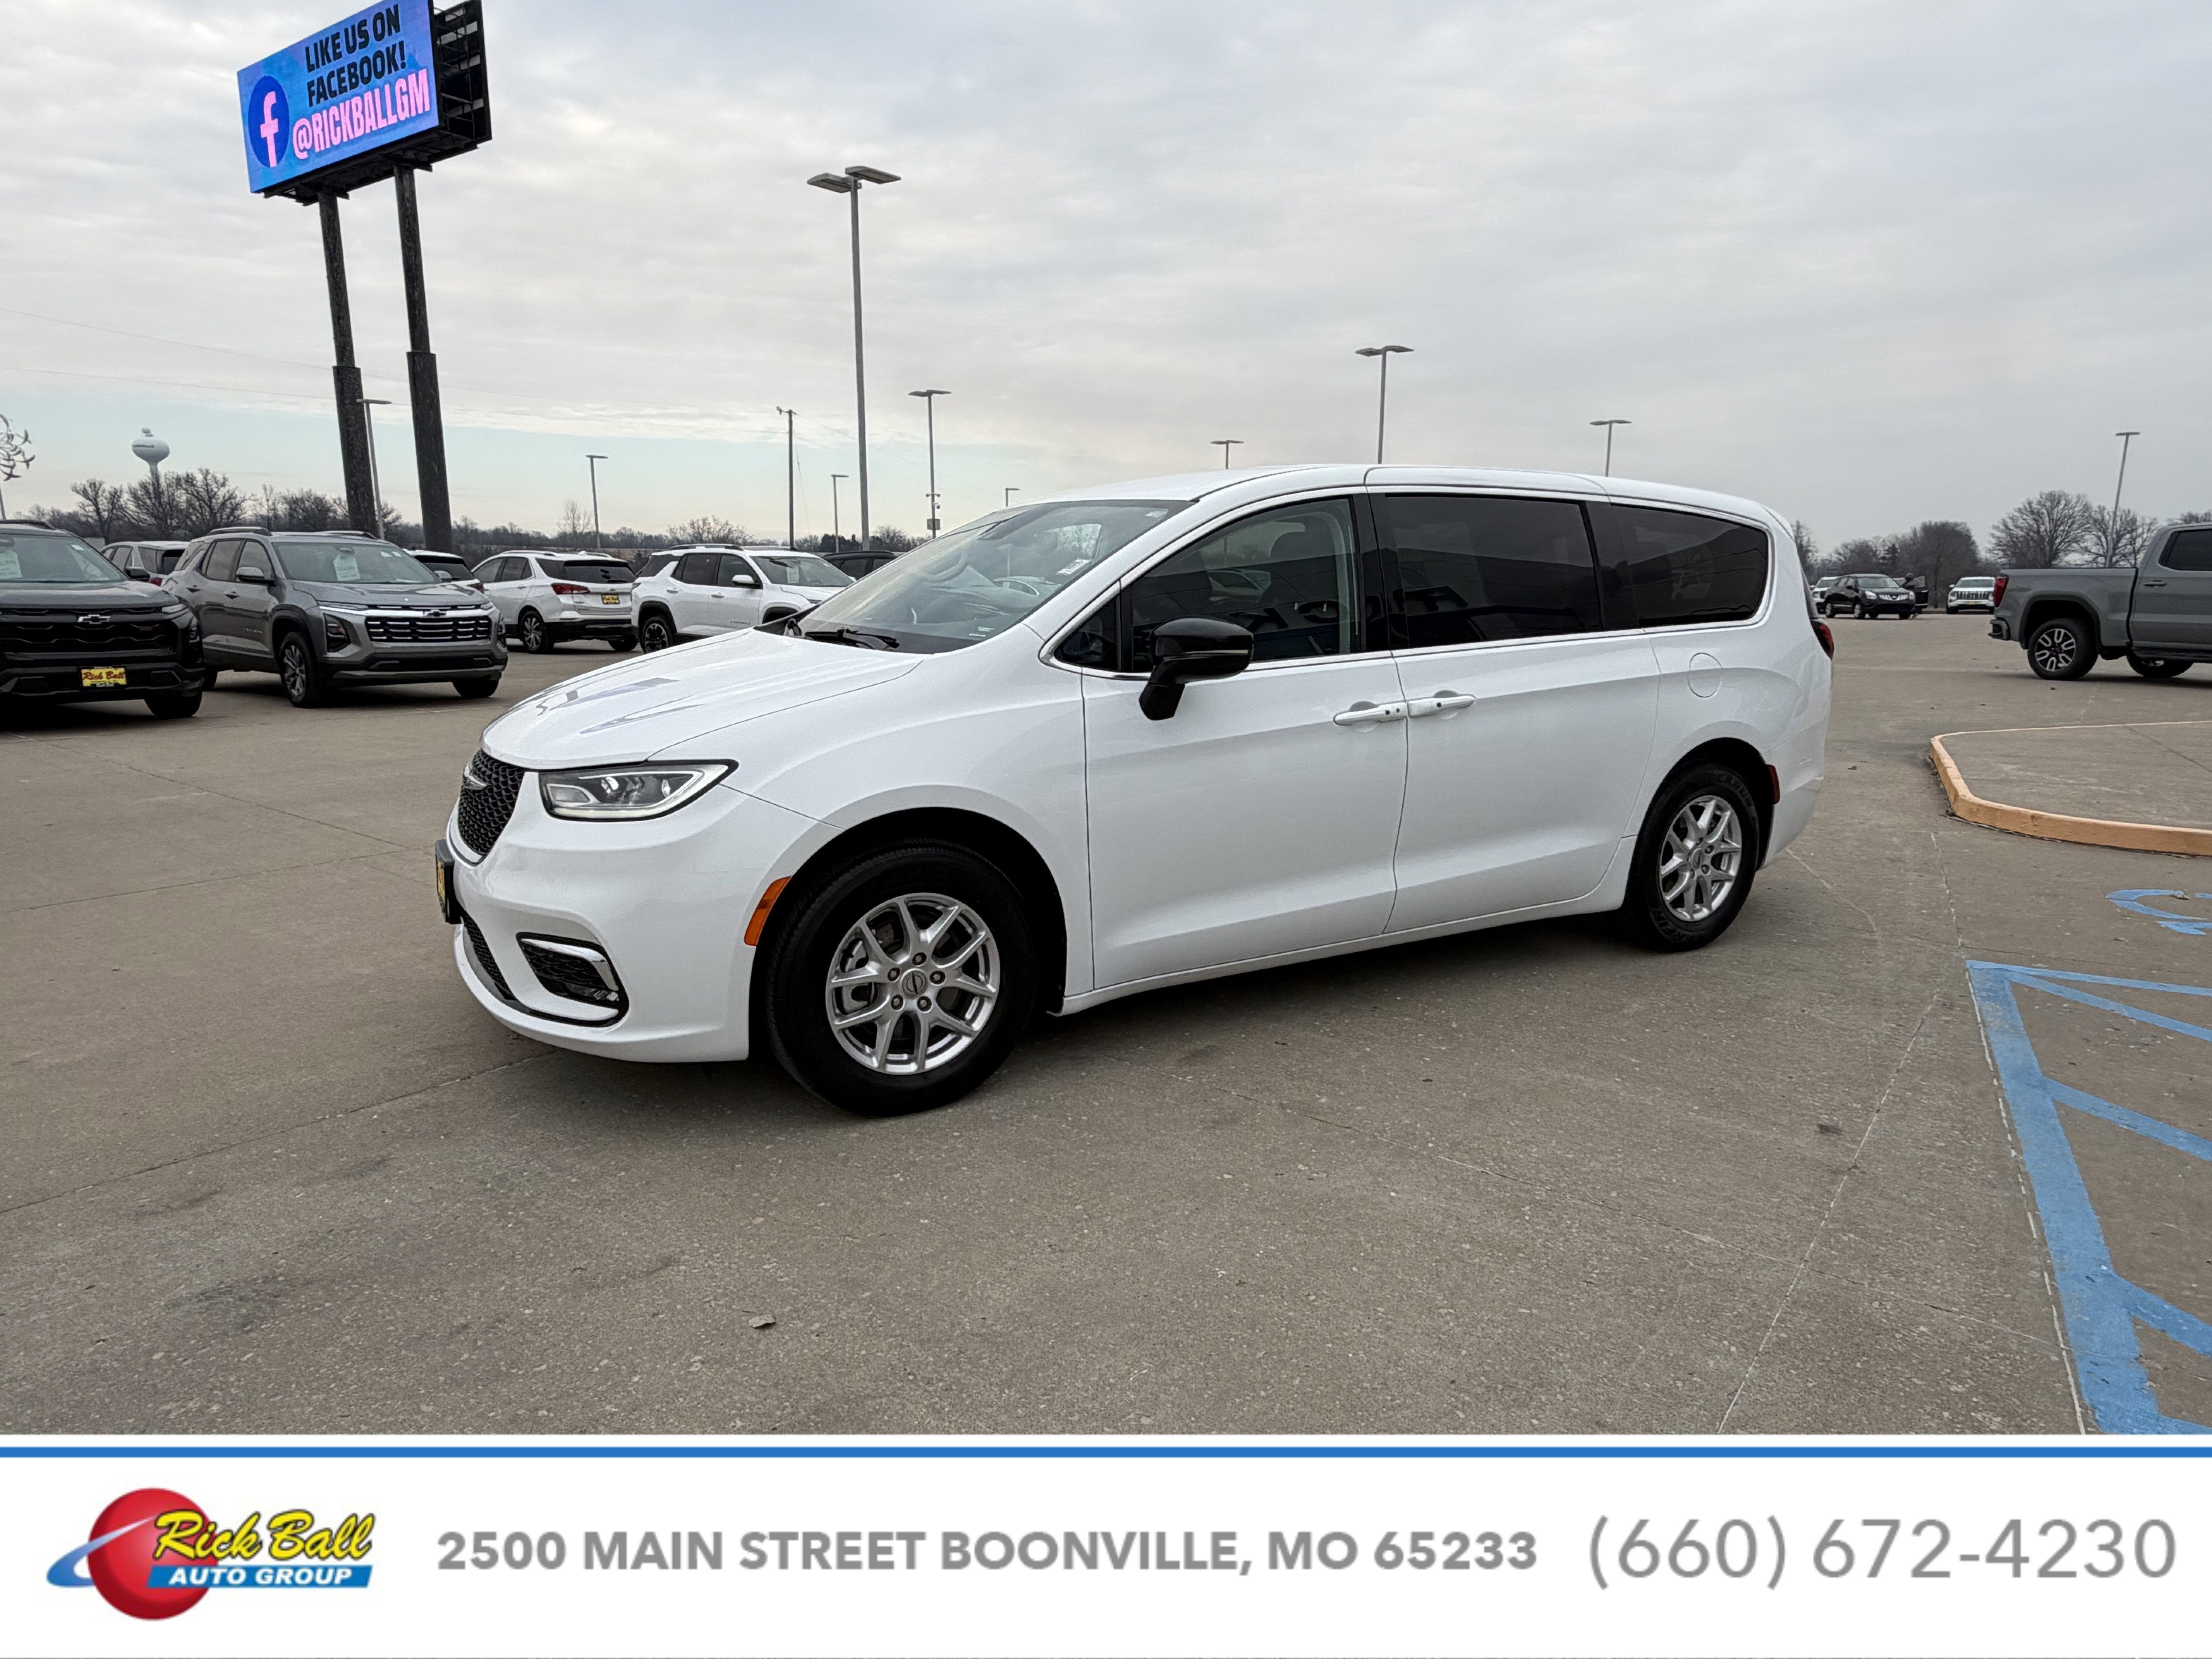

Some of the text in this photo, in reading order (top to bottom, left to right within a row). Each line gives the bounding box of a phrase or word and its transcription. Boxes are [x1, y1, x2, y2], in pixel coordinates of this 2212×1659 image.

[305, 3, 401, 73] LIKE US ON
[307, 40, 407, 107] FACEBOOK!
[292, 68, 431, 160] @RICKBALLGM
